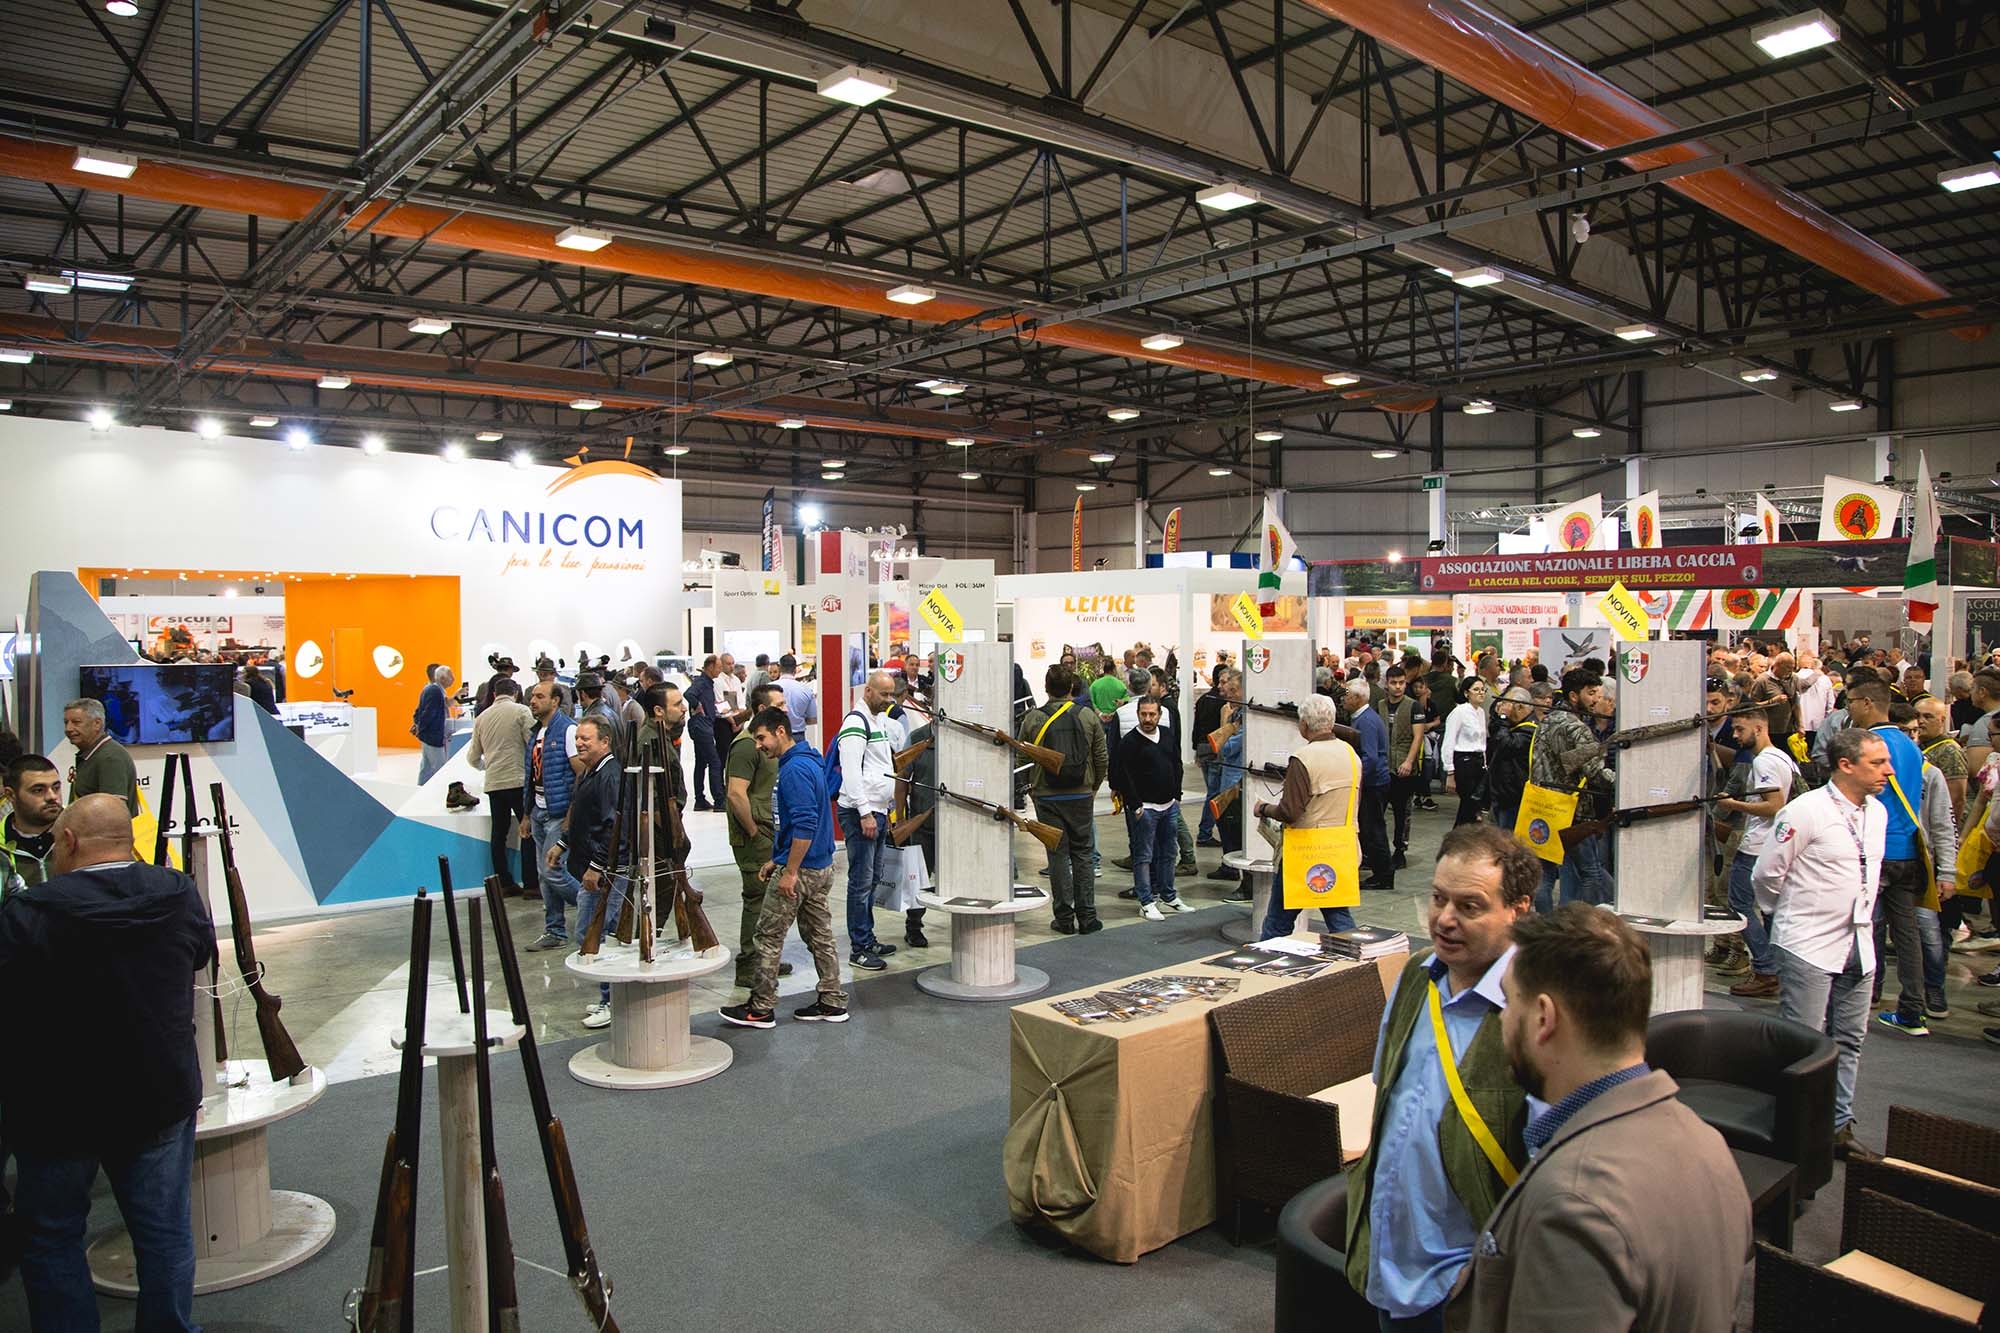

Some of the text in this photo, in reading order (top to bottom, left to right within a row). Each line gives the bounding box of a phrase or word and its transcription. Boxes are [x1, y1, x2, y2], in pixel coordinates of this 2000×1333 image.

[430, 505, 644, 550] CANICOM
[501, 552, 530, 576] per
[539, 548, 553, 568] le
[586, 557, 647, 578] passioni
[1438, 552, 1737, 575] ASSOCIAZIONE NAZIONALE LIBERA CACCIA
[1468, 572, 1696, 588] LA CACCIA NEL CUORE, SEMPRE SUL PEZZO!
[1076, 613, 1098, 623] Cani
[1106, 613, 1136, 623] Caccia
[1497, 617, 1538, 625] REGIONE UMBRIA
